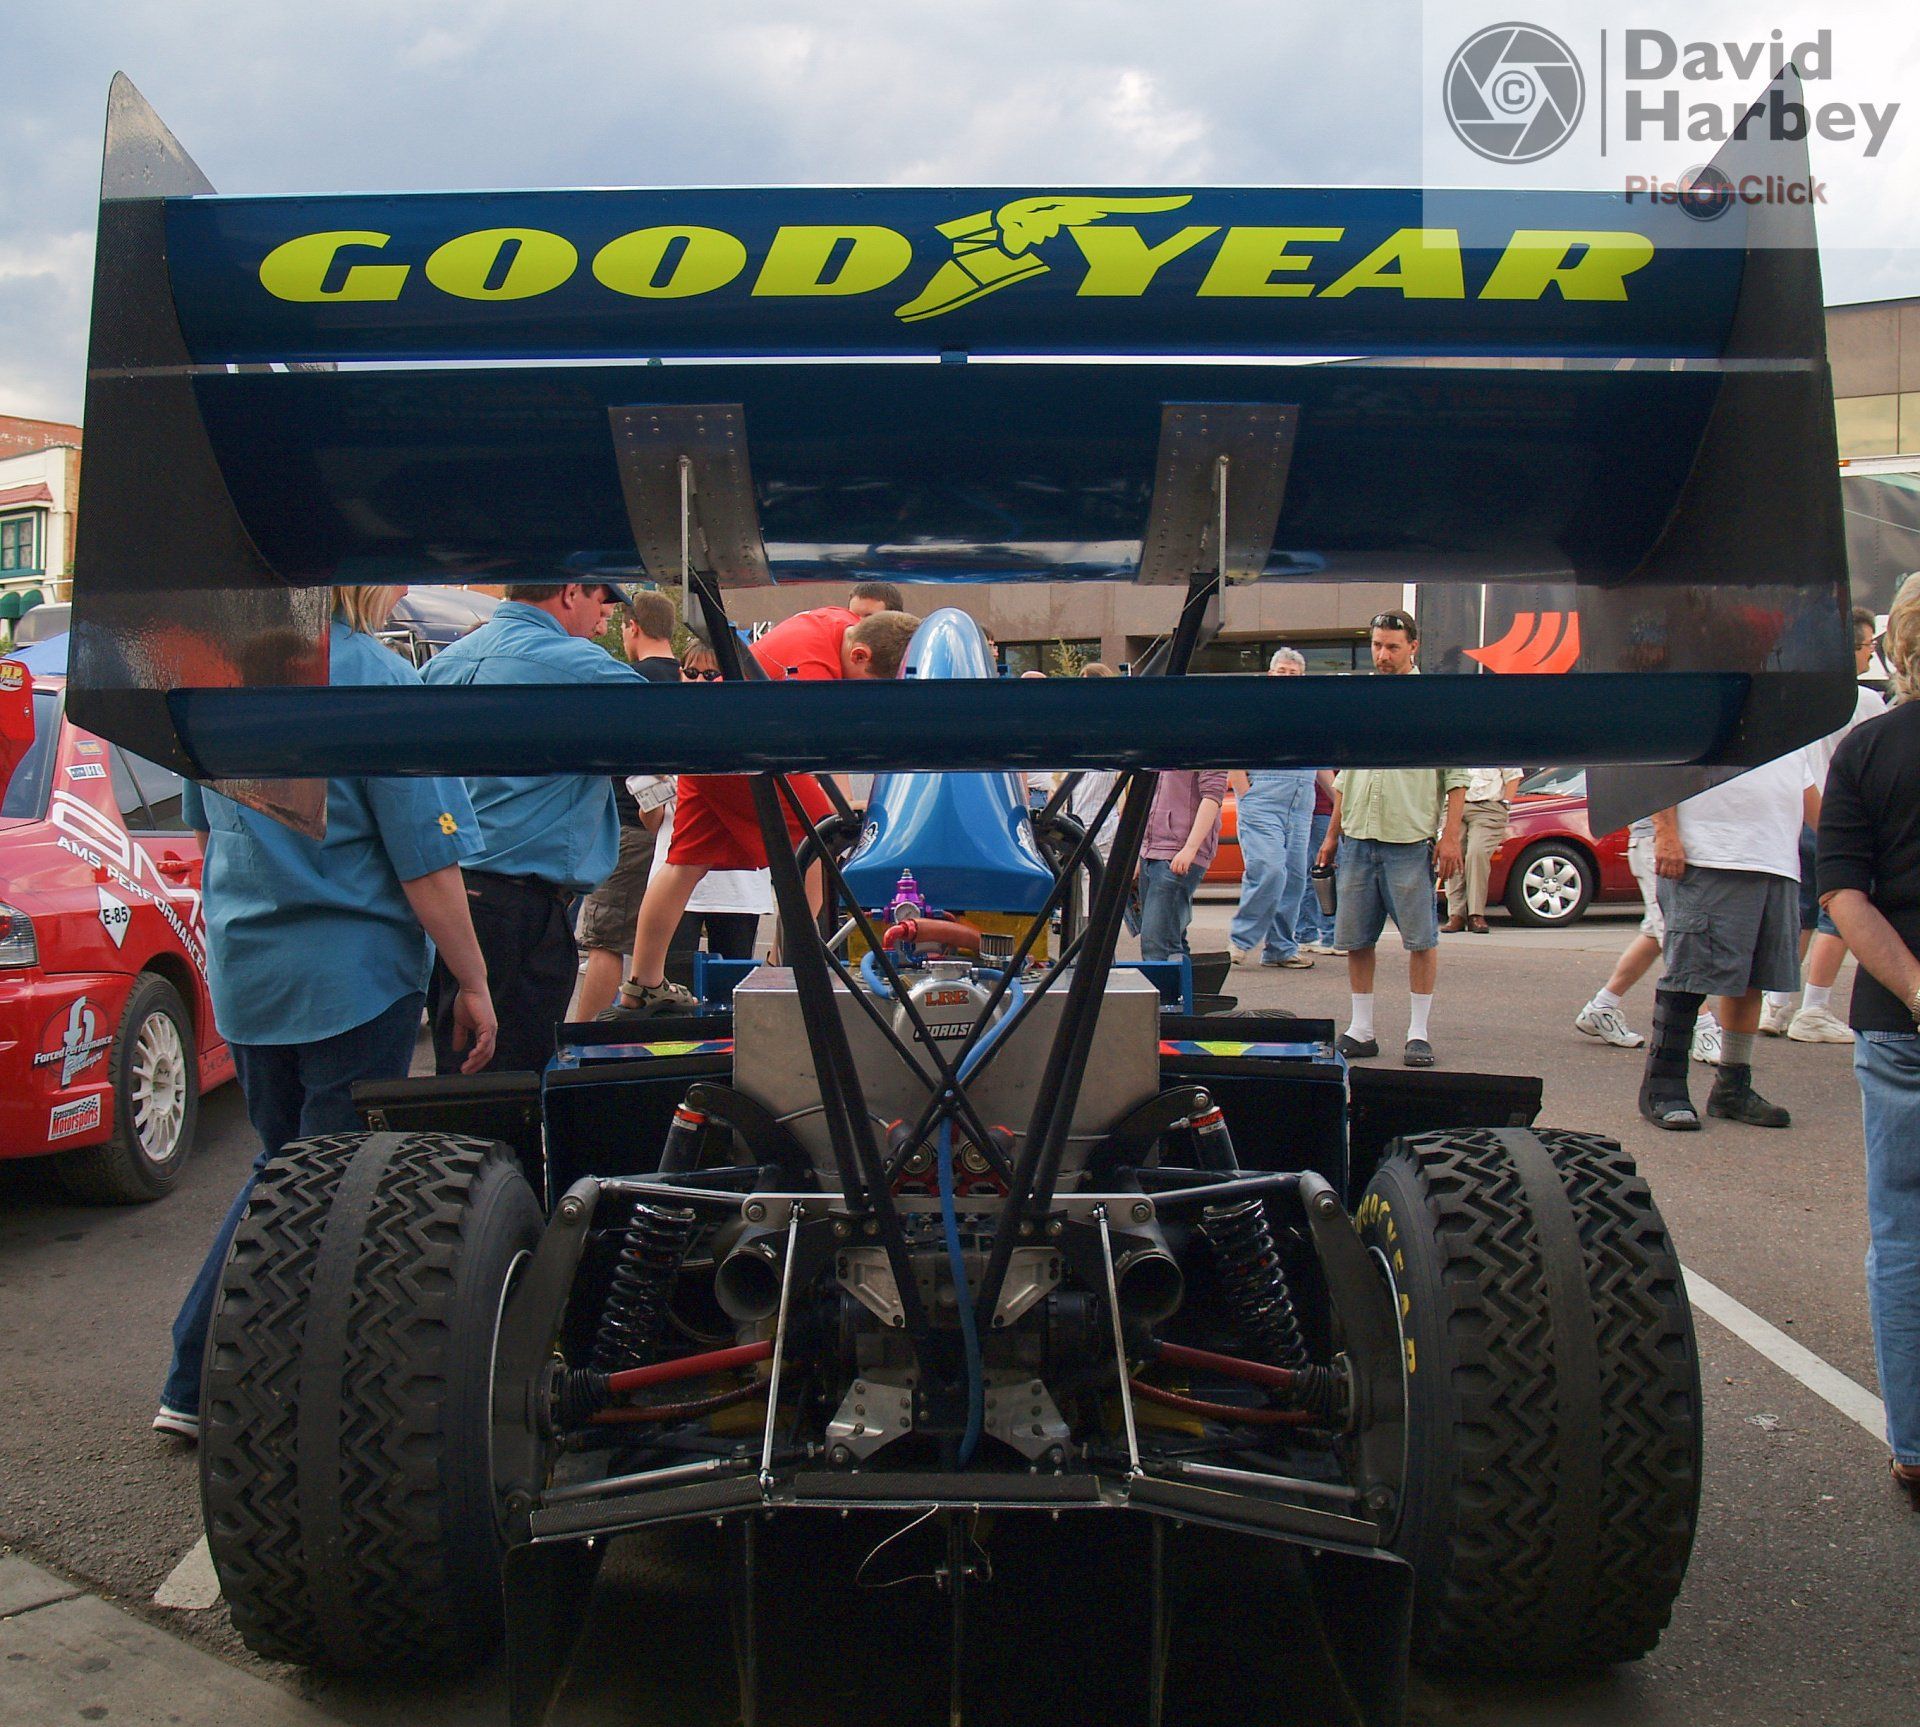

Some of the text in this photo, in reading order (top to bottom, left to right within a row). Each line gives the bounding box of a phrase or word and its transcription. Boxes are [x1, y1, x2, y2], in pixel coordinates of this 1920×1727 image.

[57, 836, 102, 870] AMS
[102, 907, 129, 925] E-85
[34, 1046, 65, 1065] Forced
[65, 1035, 113, 1057] Performance
[51, 1106, 98, 1135] Motorsports
